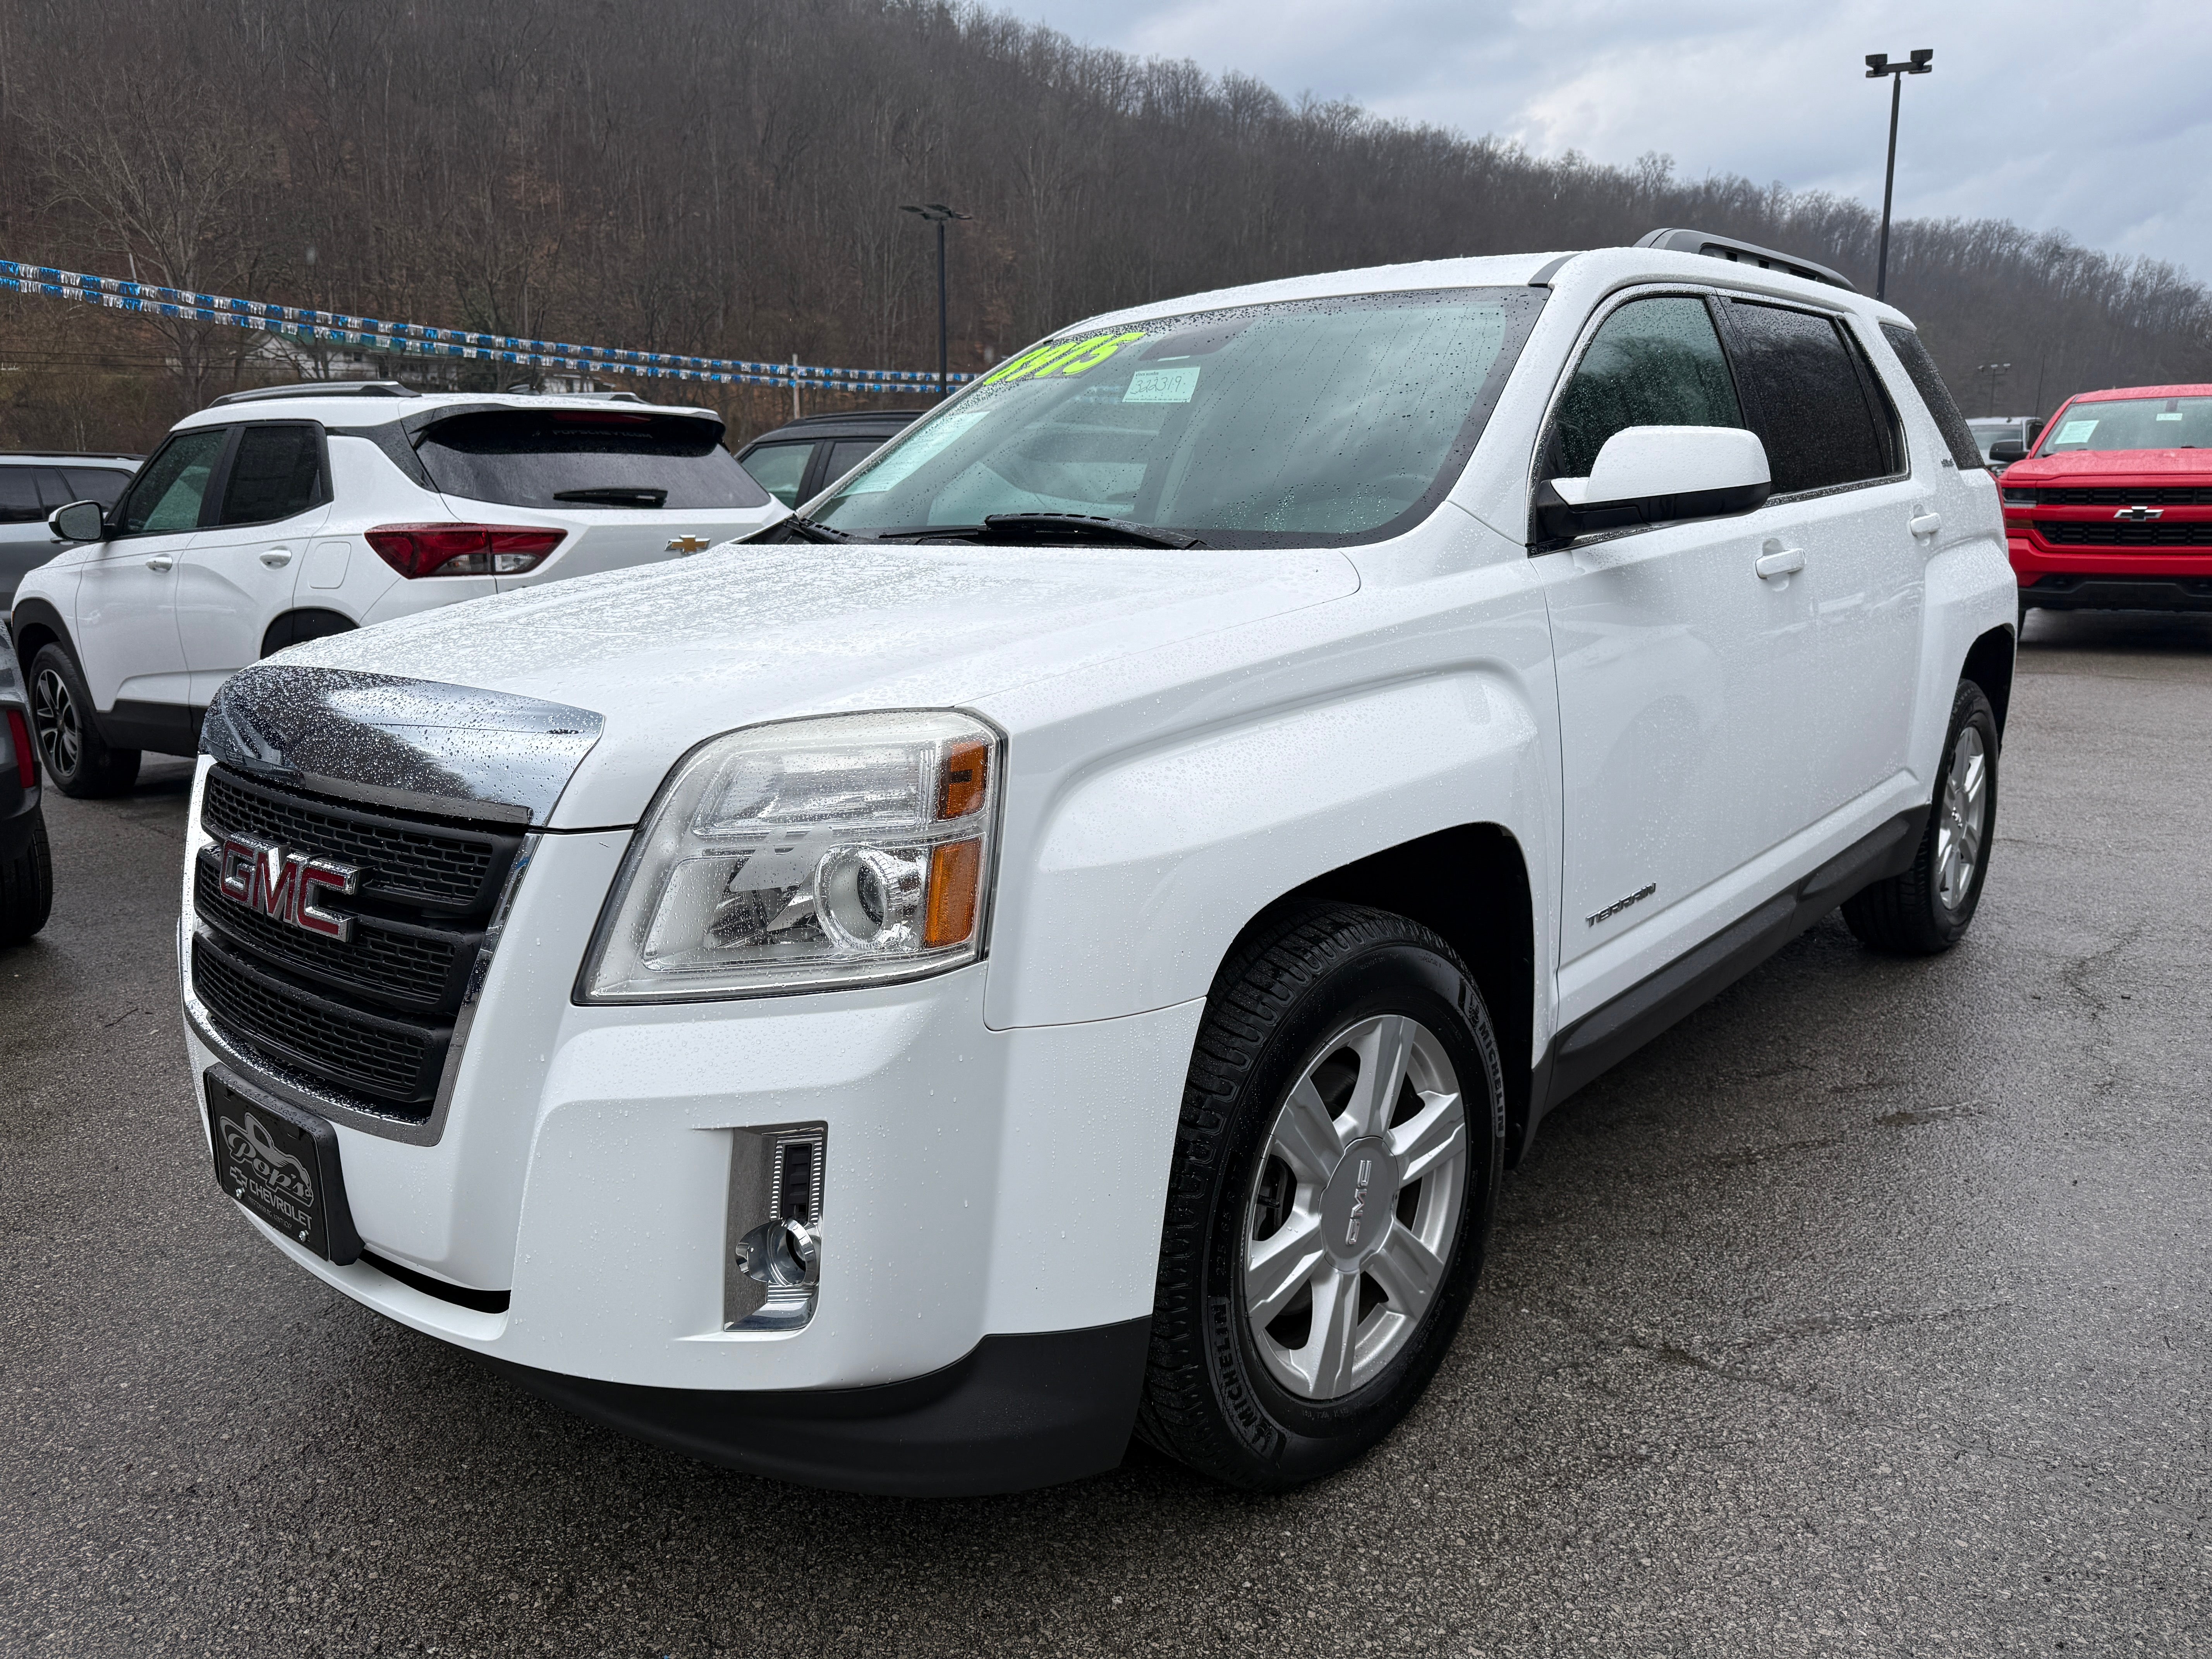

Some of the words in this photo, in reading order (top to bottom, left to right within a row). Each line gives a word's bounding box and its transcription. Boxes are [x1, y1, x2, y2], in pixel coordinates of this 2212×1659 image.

[1130, 376, 1182, 394] 322319
[220, 833, 358, 942] GMC
[1585, 881, 1657, 928] TERRAIN
[1478, 1022, 1504, 1133] MICHELIN
[228, 1133, 313, 1200] Pop's
[249, 1179, 312, 1230] CHEVROLET
[1345, 1160, 1372, 1246] GMC
[1211, 1304, 1258, 1428] MICHELIN
